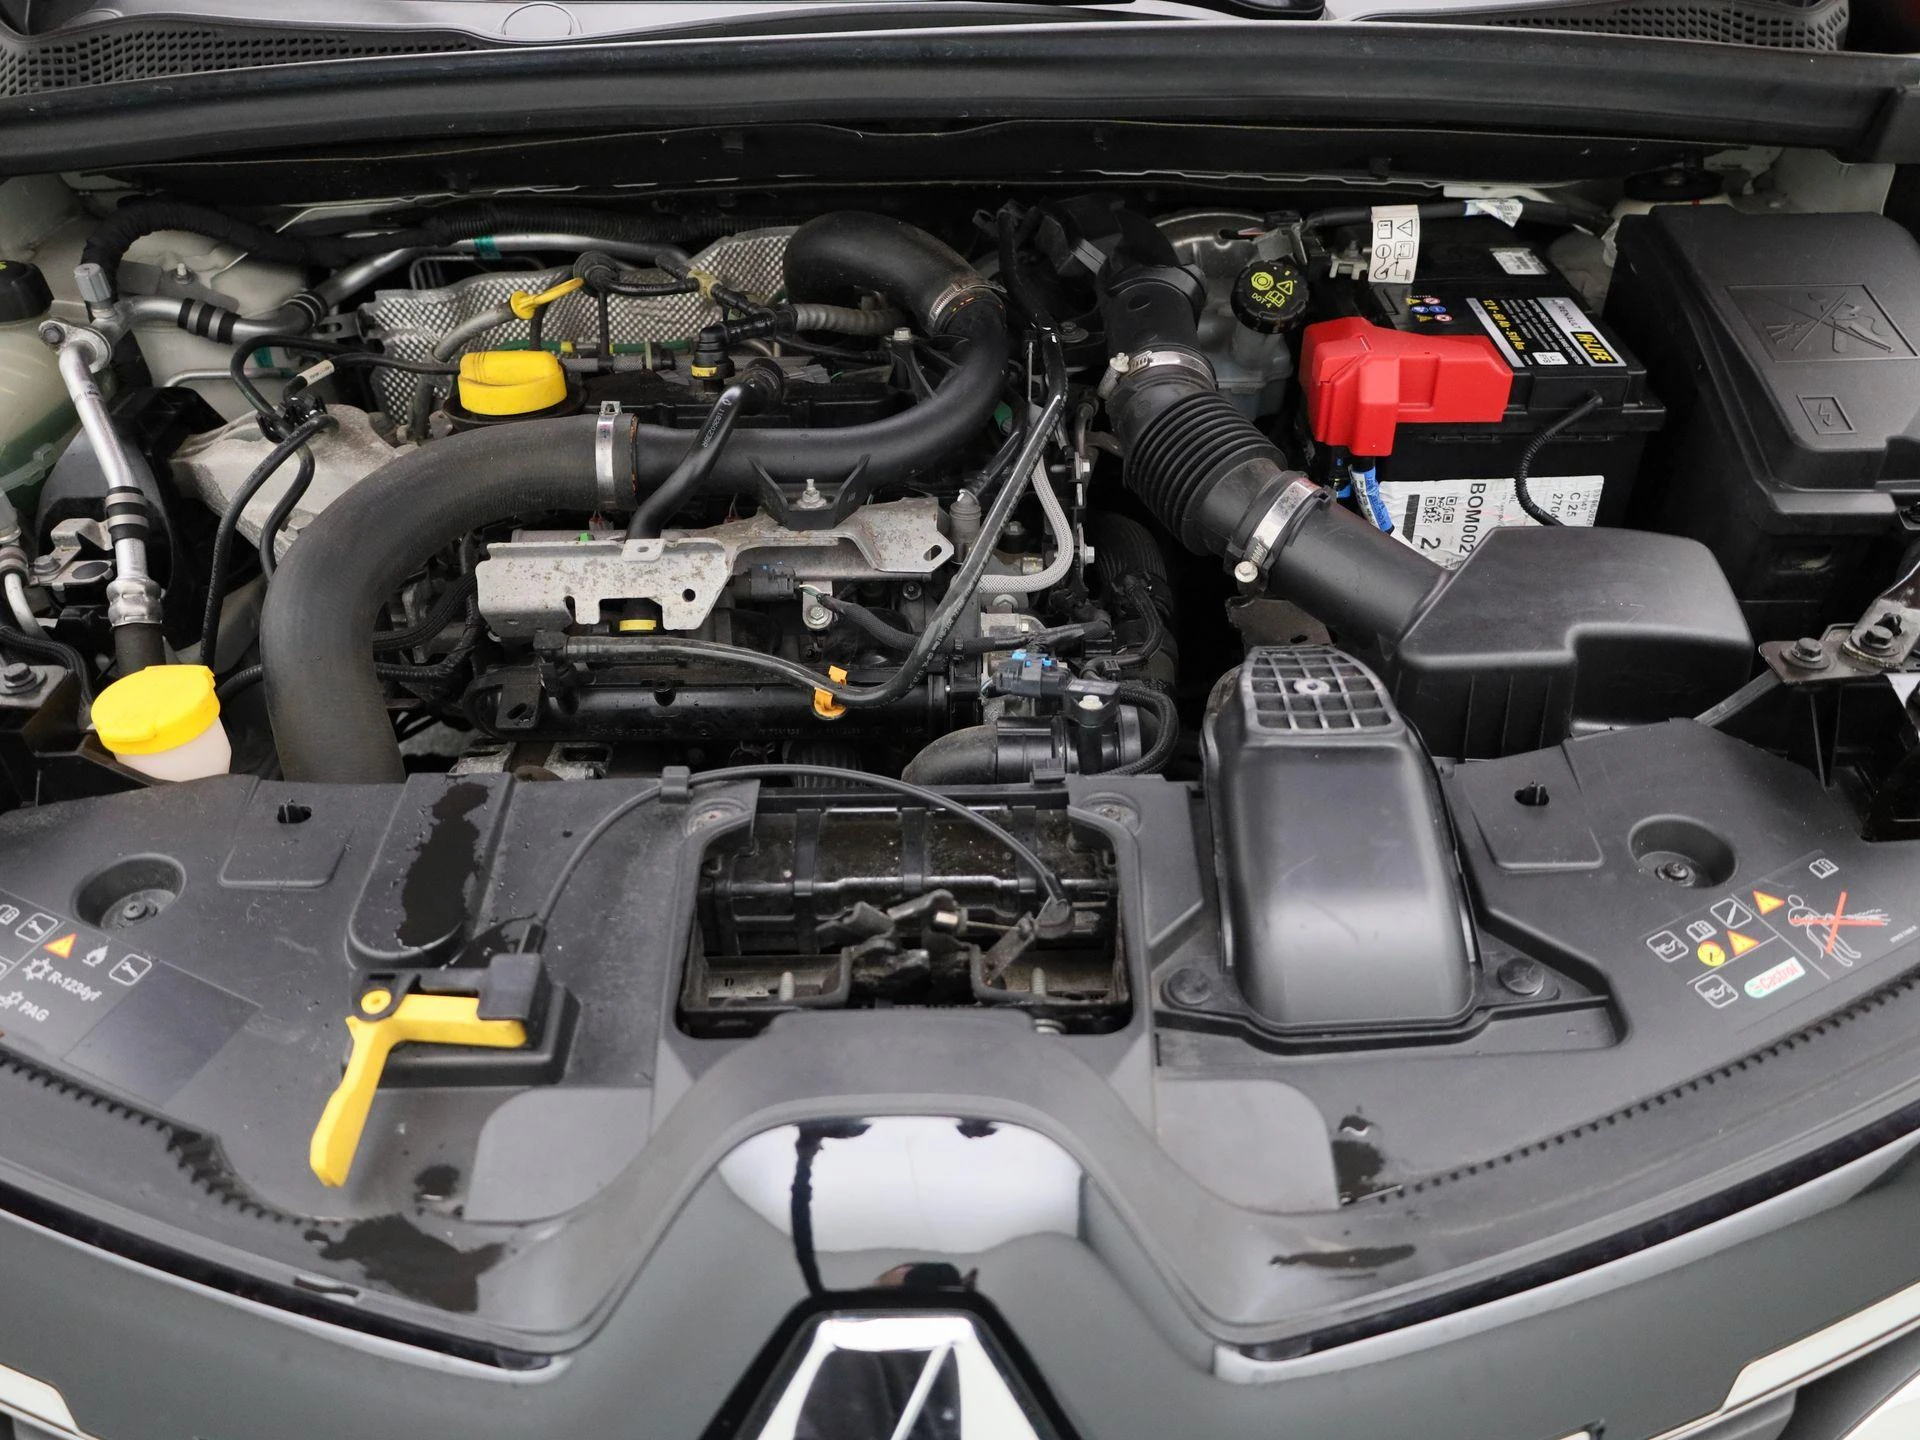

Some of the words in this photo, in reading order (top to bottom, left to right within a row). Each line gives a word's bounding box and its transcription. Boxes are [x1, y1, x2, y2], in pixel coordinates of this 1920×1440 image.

[1251, 292, 1267, 304] DOT
[1570, 492, 1581, 501] C
[1567, 504, 1579, 517] 25
[1459, 483, 1487, 554] BOM002
[1420, 537, 1441, 550] 2
[48, 970, 102, 1001] R-1234yf
[18, 1001, 50, 1022] PAG
